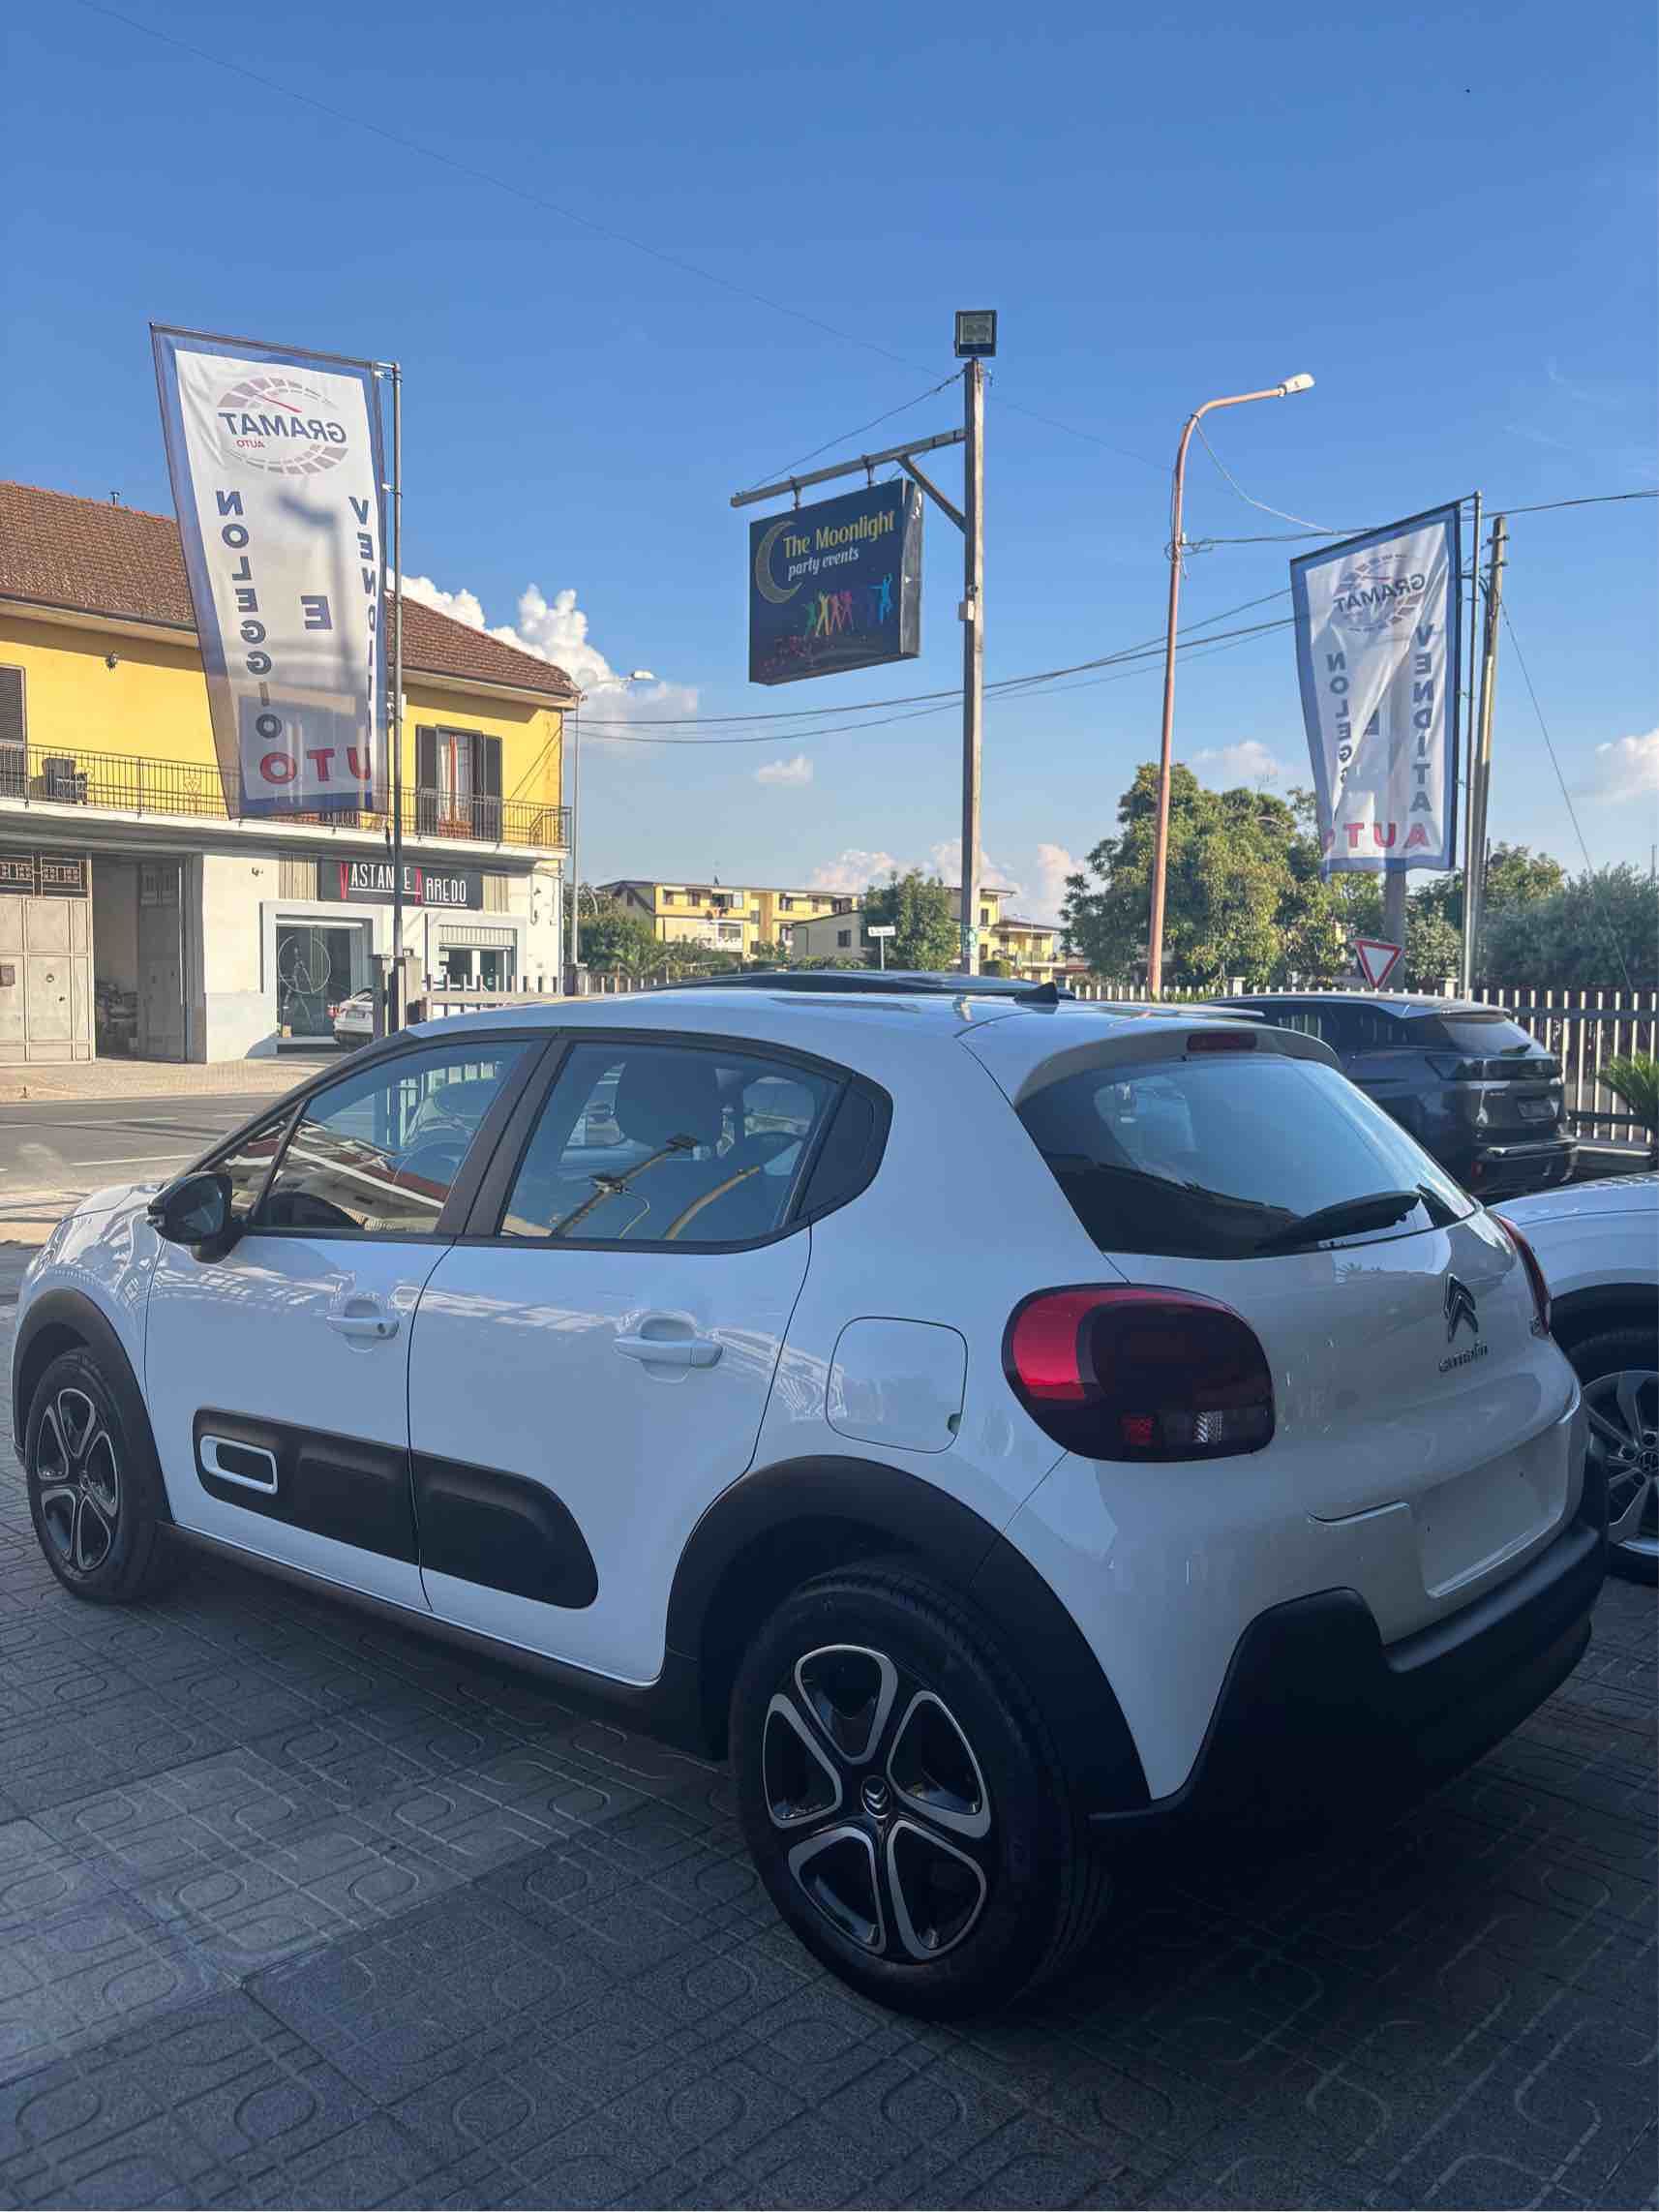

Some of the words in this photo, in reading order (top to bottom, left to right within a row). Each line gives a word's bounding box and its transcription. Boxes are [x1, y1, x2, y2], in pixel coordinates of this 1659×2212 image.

[782, 534, 811, 559] The
[815, 510, 895, 551] Moonlight
[788, 556, 820, 582] party
[823, 546, 860, 568] events
[340, 862, 411, 899] VASTANE
[414, 867, 467, 905] ARREDO
